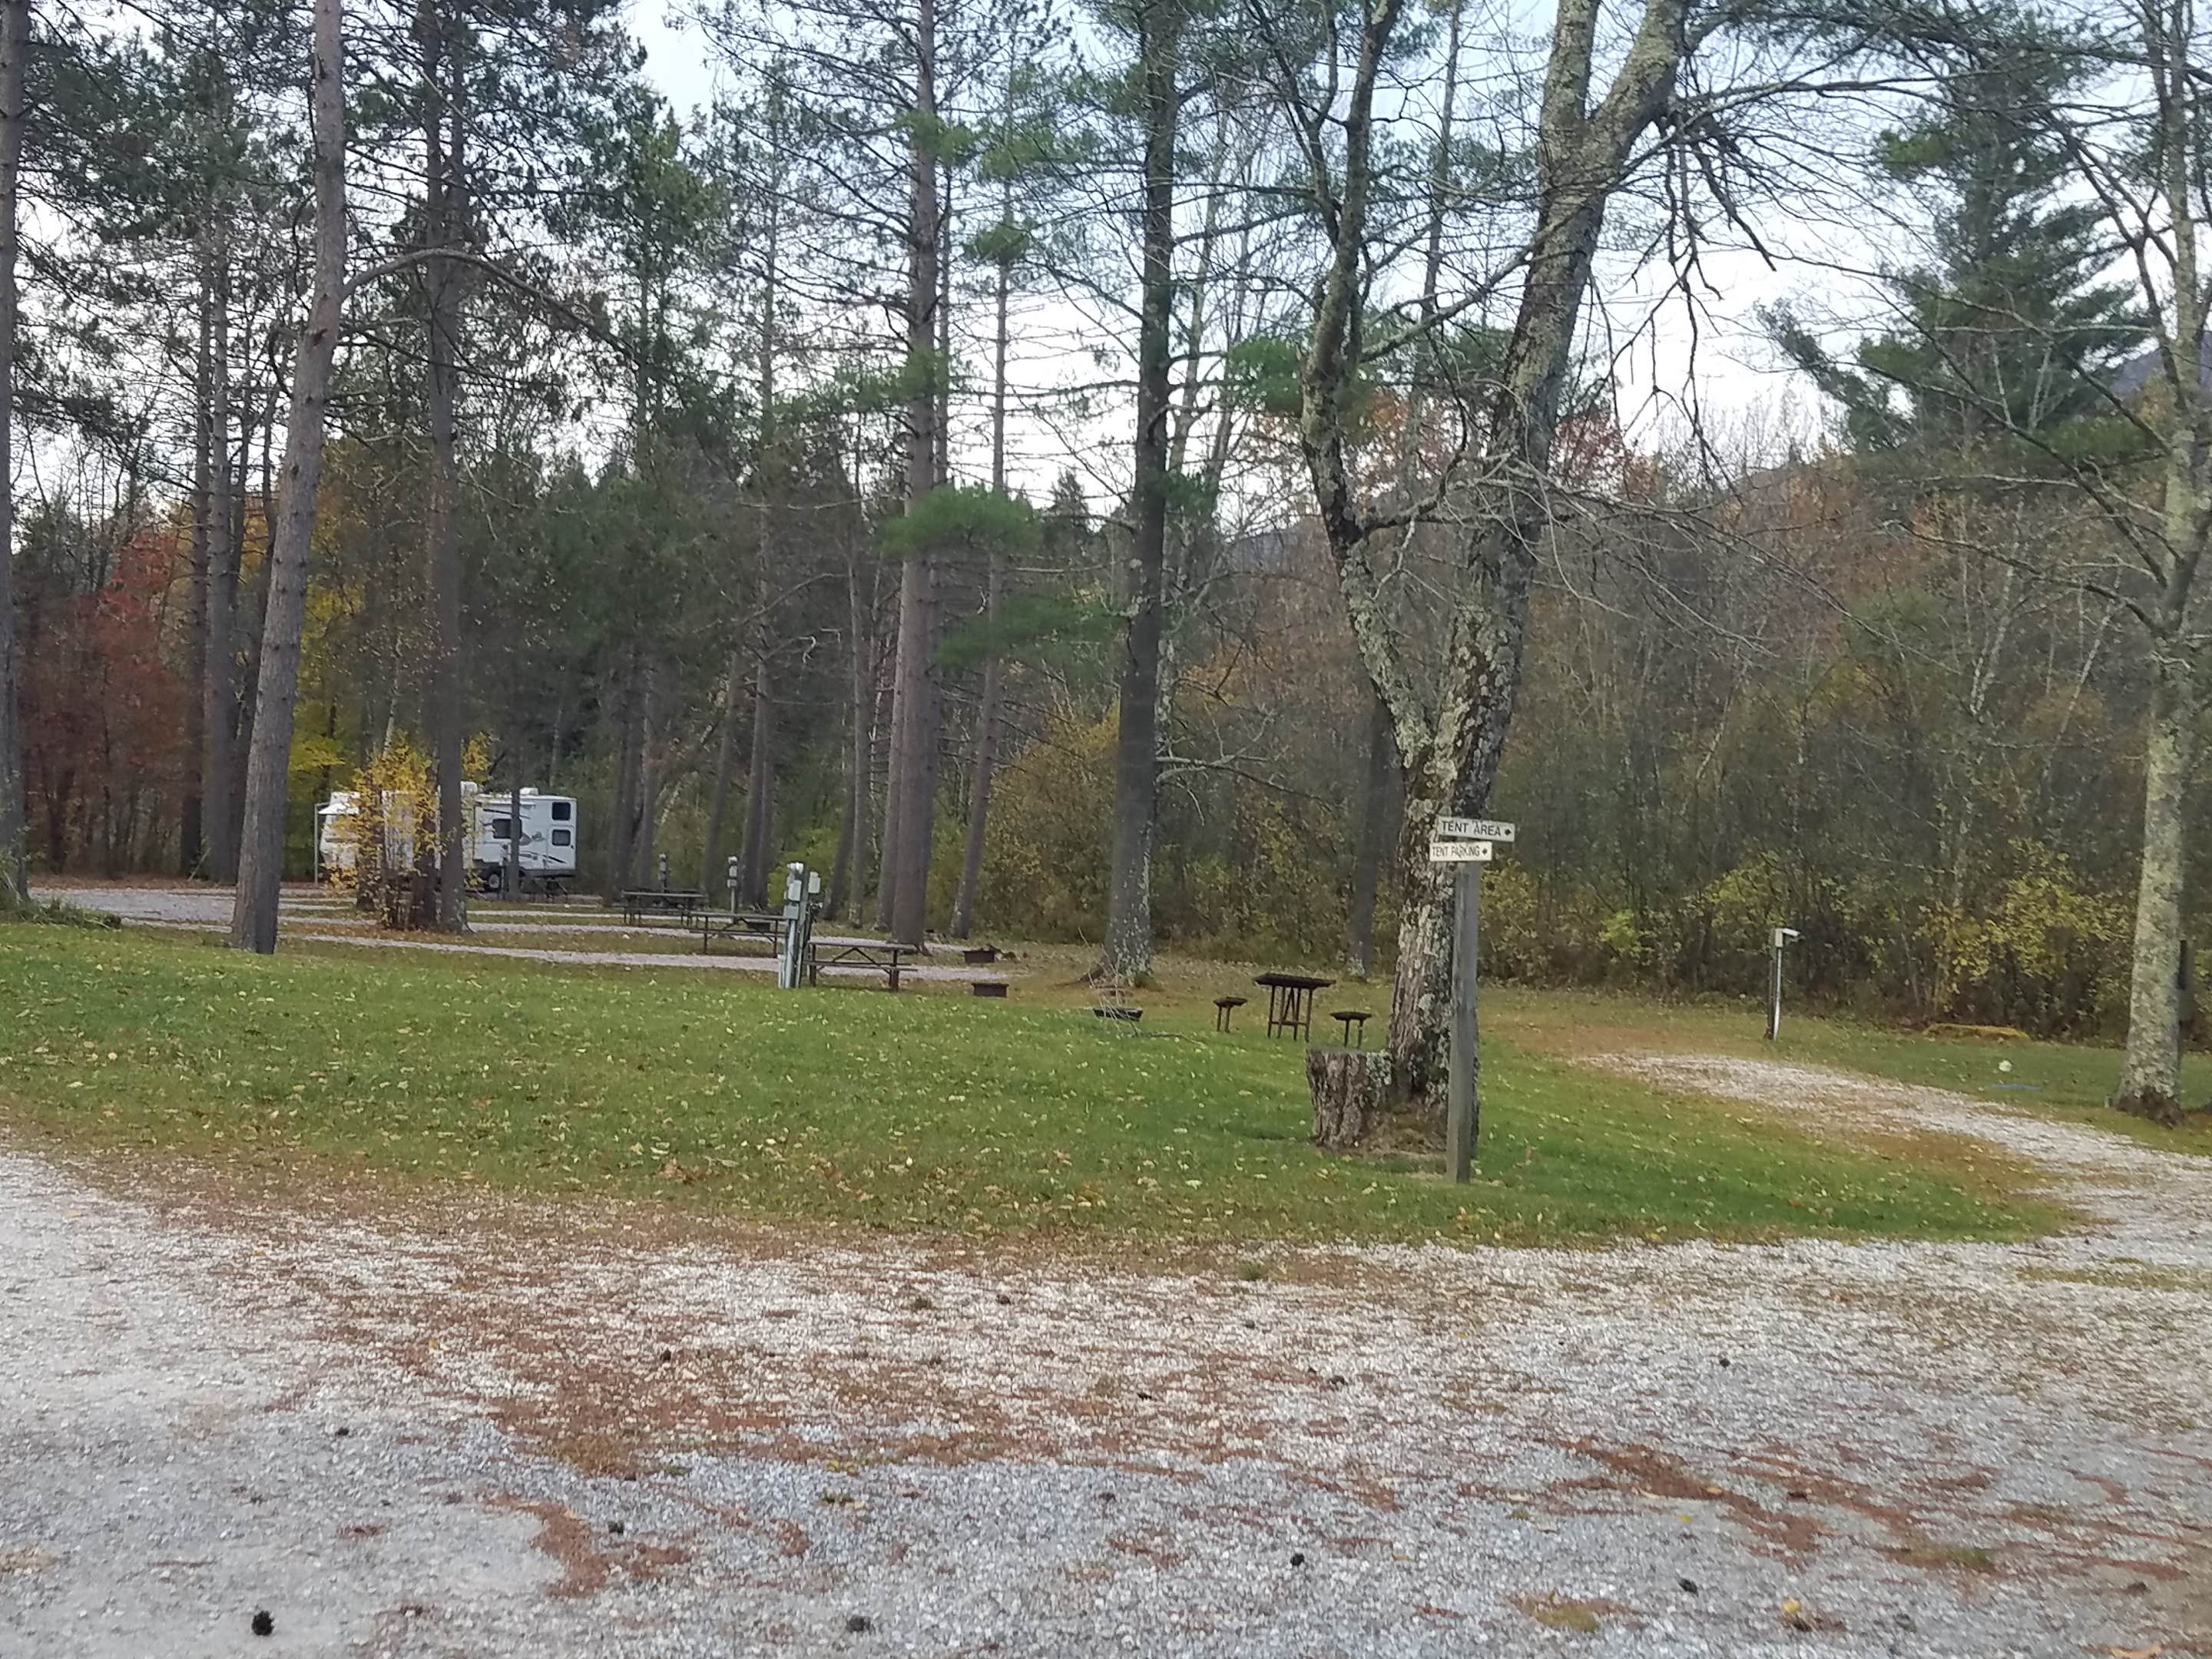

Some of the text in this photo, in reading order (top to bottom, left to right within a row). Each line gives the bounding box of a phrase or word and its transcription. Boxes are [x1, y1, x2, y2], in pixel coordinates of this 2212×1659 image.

[1442, 821, 1502, 837] TENT AREA
[1432, 846, 1480, 858] TENT PARKING
